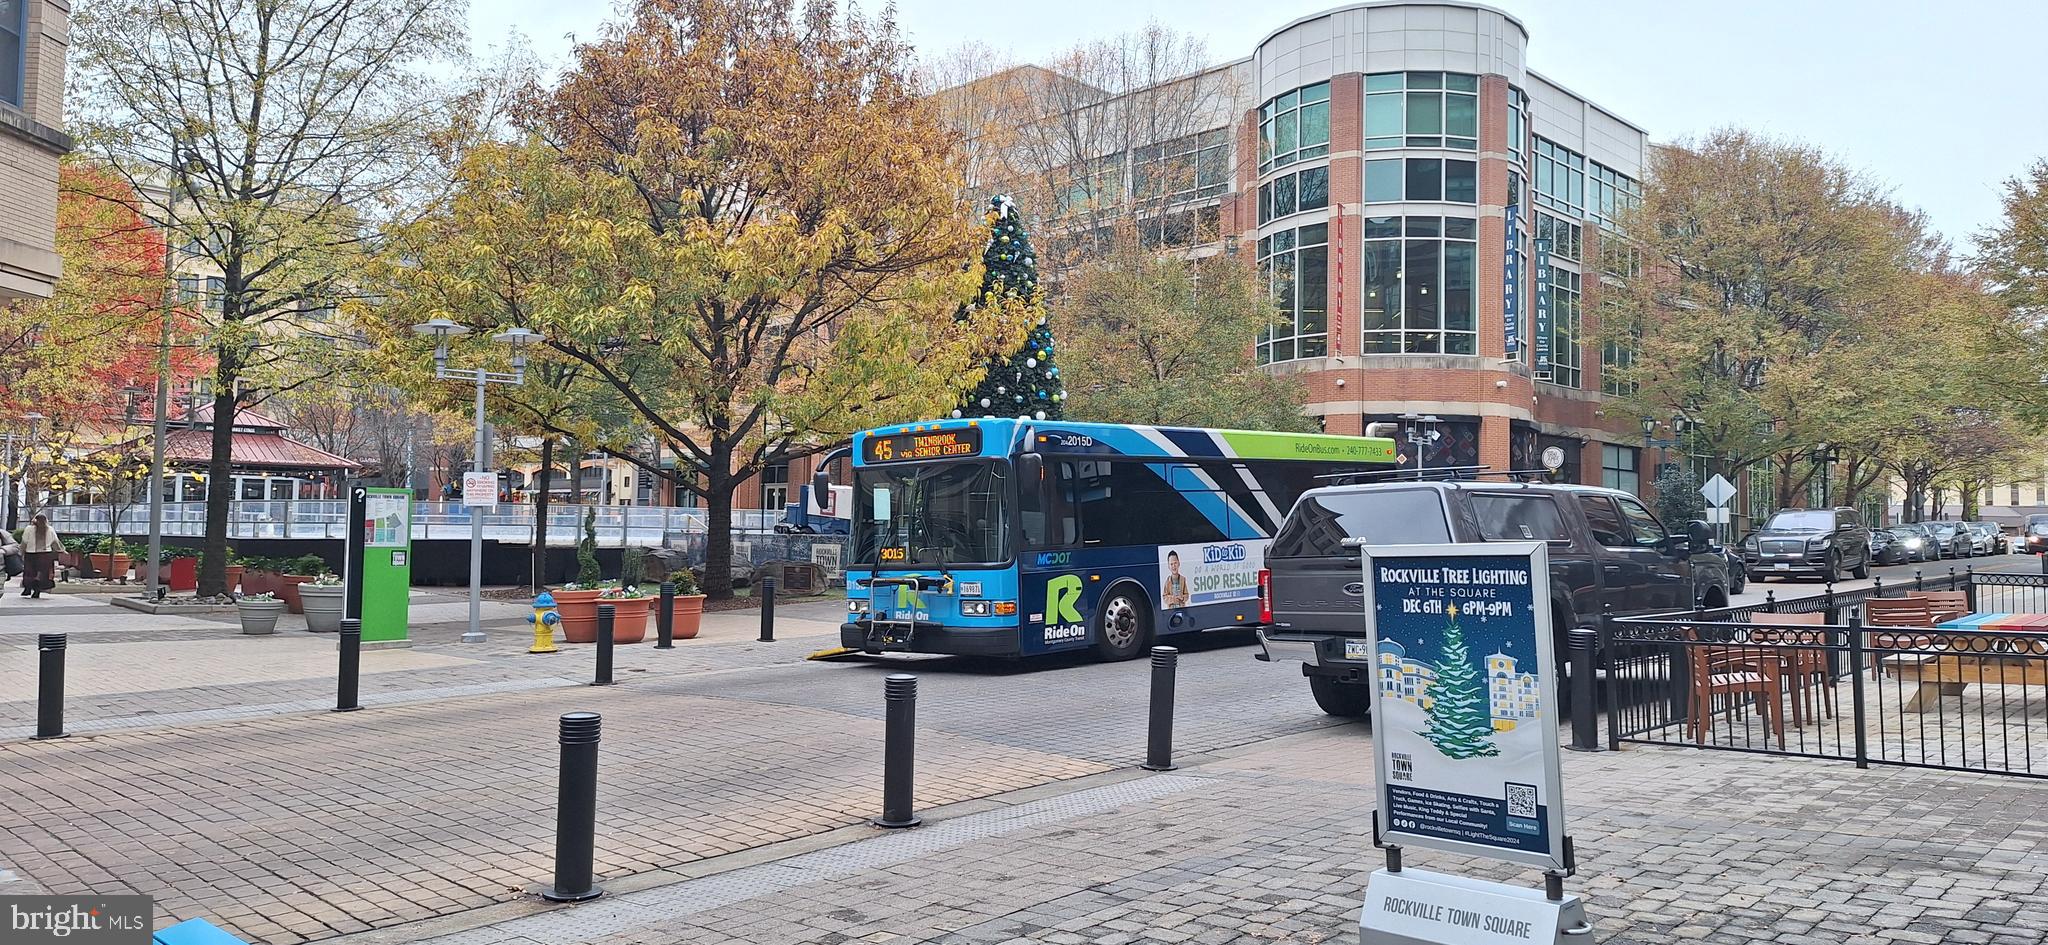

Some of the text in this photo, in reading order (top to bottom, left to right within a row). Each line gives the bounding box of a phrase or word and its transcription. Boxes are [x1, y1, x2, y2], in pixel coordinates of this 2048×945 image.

[1505, 210, 1514, 309] LIBRARY
[1538, 242, 1547, 332] LIBRARY
[914, 432, 957, 448] TWINBROOK
[1068, 436, 1092, 446] 2015D
[874, 439, 893, 460] 45
[900, 442, 971, 458] via SENIOR CENTER
[1295, 442, 1382, 457] RideOnBus.com 240-777-7433
[880, 548, 904, 560] 3015
[1037, 552, 1072, 565] MCDOT
[816, 556, 837, 566] TOWN
[1194, 571, 1258, 592] SHOP RESALE
[1380, 566, 1528, 585] ROCKVILLE TREE LIGHTING
[1408, 587, 1497, 598] AT THE SQUARE
[1402, 599, 1512, 616] DEC 6TH 6PM-9PM
[1391, 752, 1412, 760] ROCKVILLE
[1392, 759, 1413, 772] TOWN
[1392, 770, 1413, 782] SQUARE
[1430, 793, 1446, 801] Drinks,
[1463, 798, 1479, 806] Crafts,
[1430, 808, 1445, 816] Teddy
[1450, 811, 1467, 819] Special
[1480, 808, 1496, 816] Santa,
[1393, 810, 1424, 819] Performances
[1459, 819, 1488, 829] Community!
[1523, 823, 1538, 831] Here
[1465, 831, 1520, 845] #LightTheSquare2024
[1383, 896, 1532, 939] ROCKVILLE TOWN SQUARE
